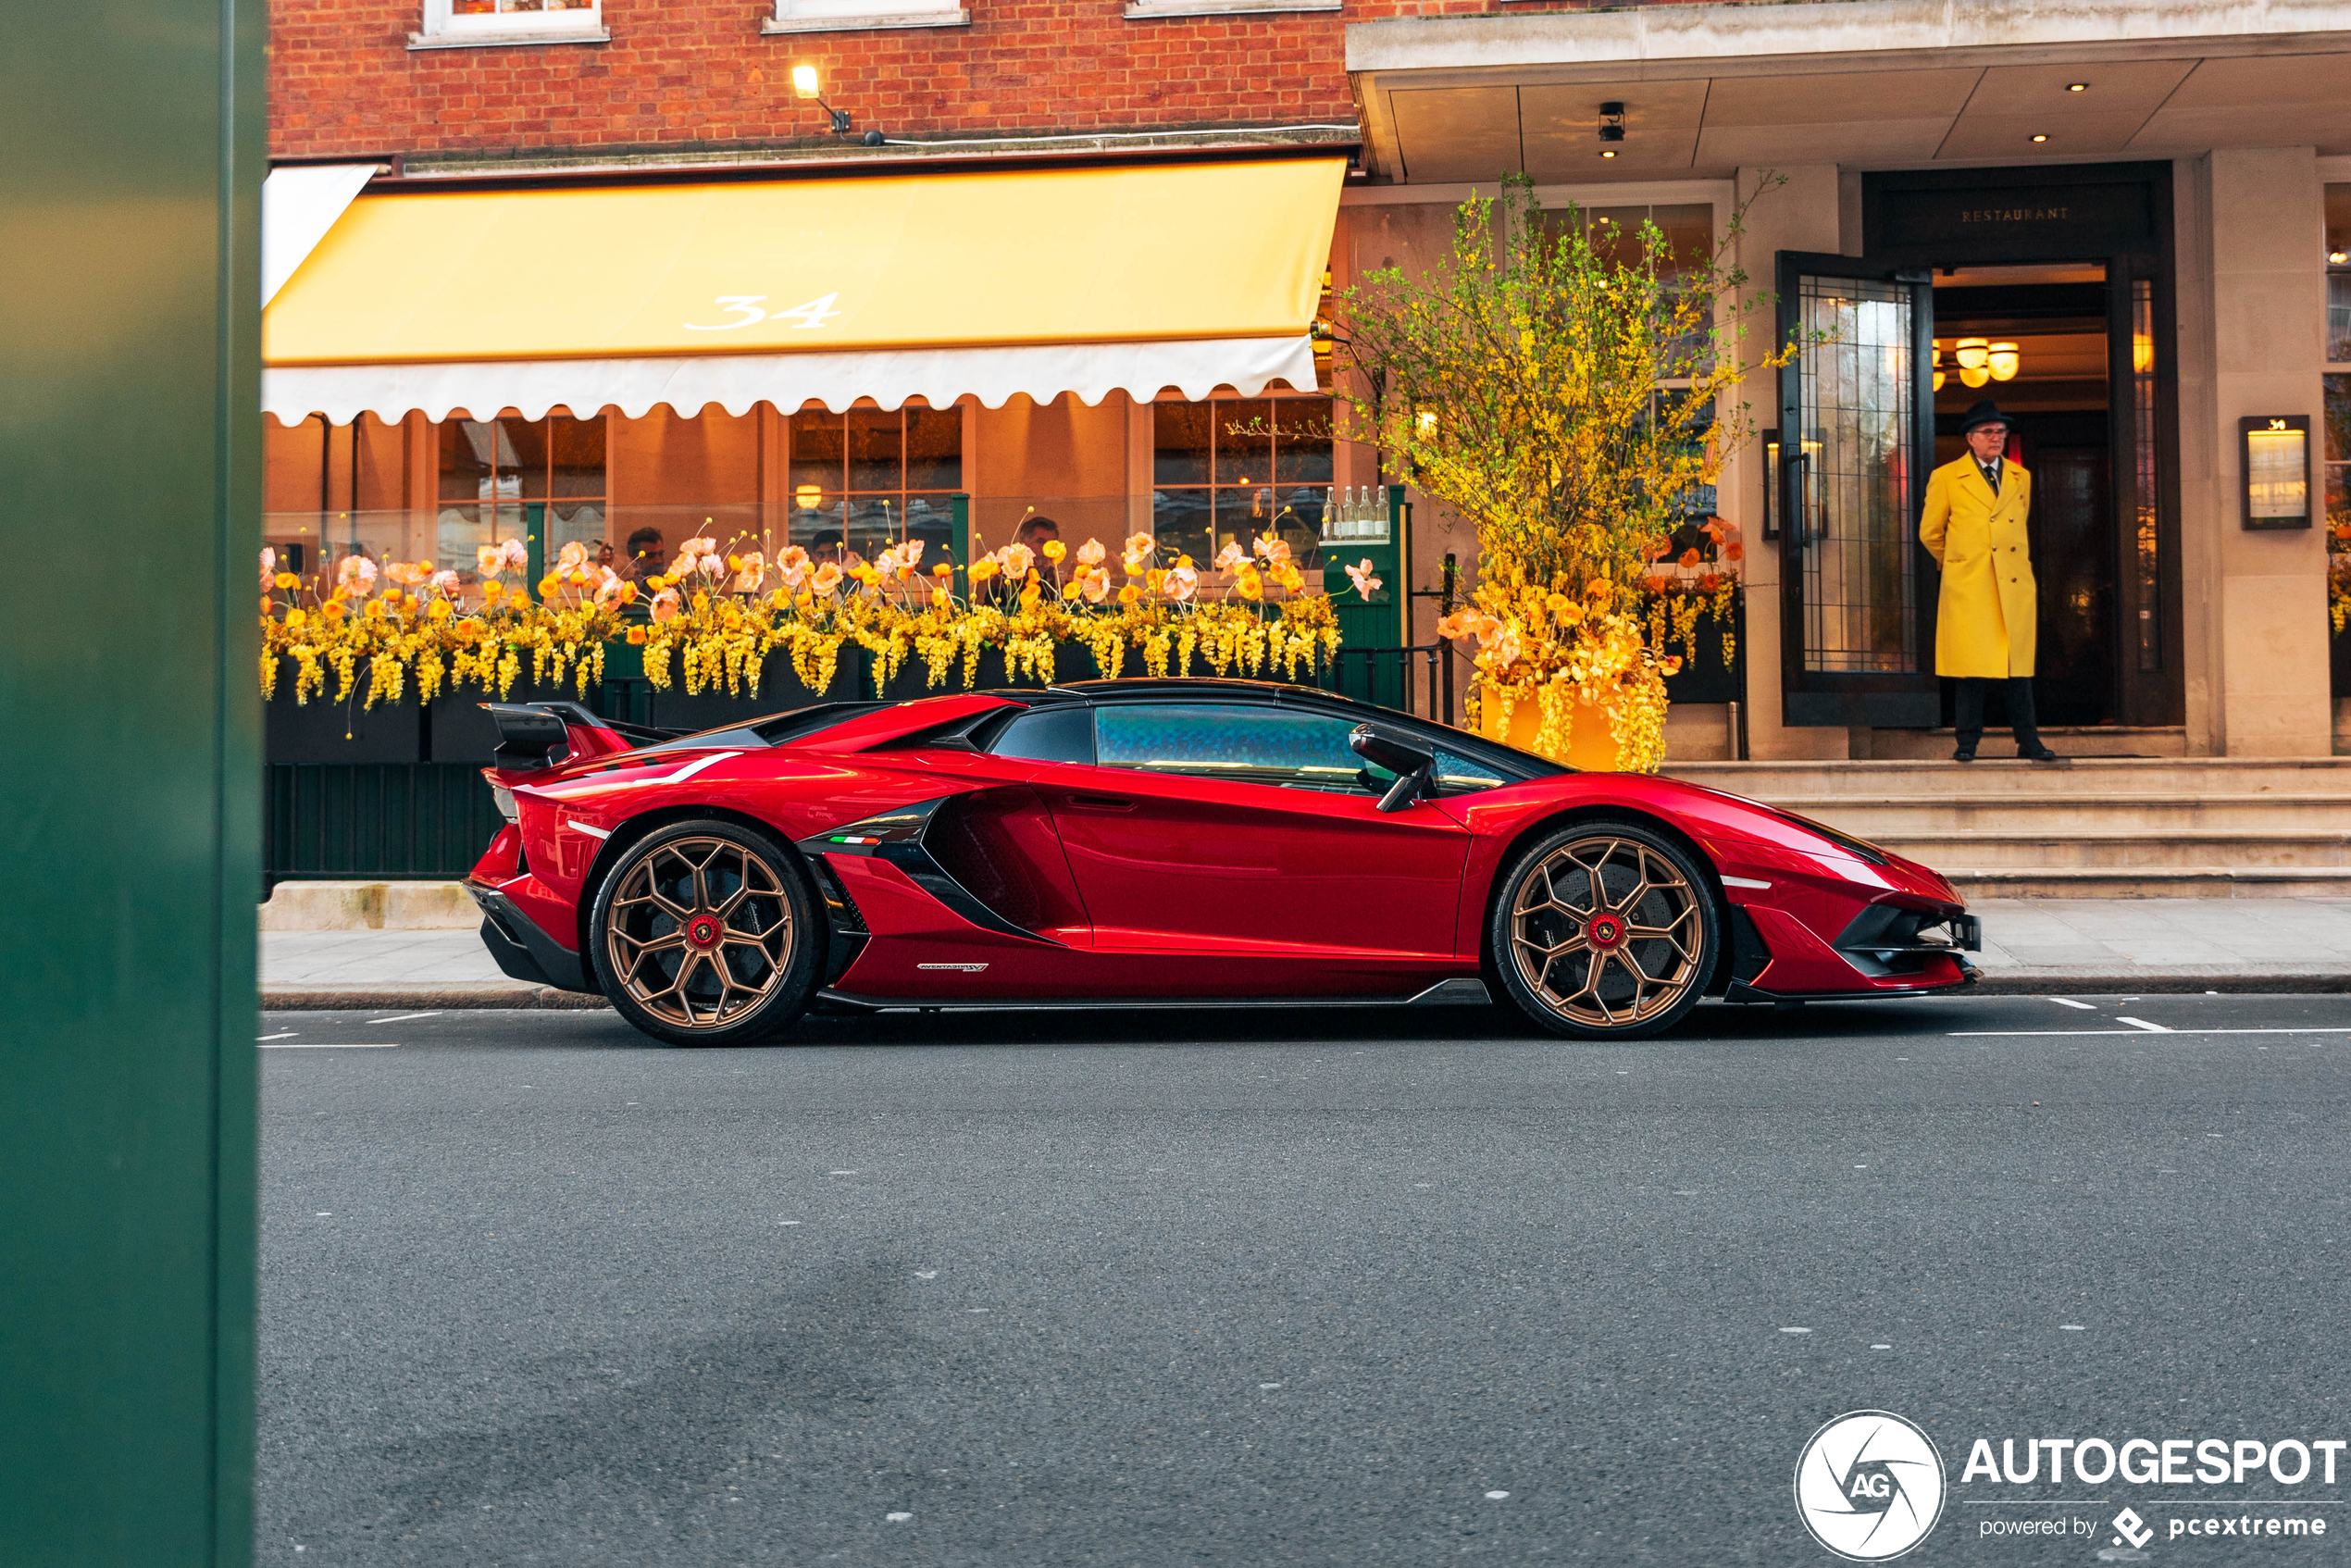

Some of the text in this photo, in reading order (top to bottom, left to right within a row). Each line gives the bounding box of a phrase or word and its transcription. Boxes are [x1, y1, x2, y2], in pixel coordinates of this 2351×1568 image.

[1962, 207, 2069, 222] RESTAURANT
[682, 291, 841, 331] 34
[2268, 418, 2286, 430] 34
